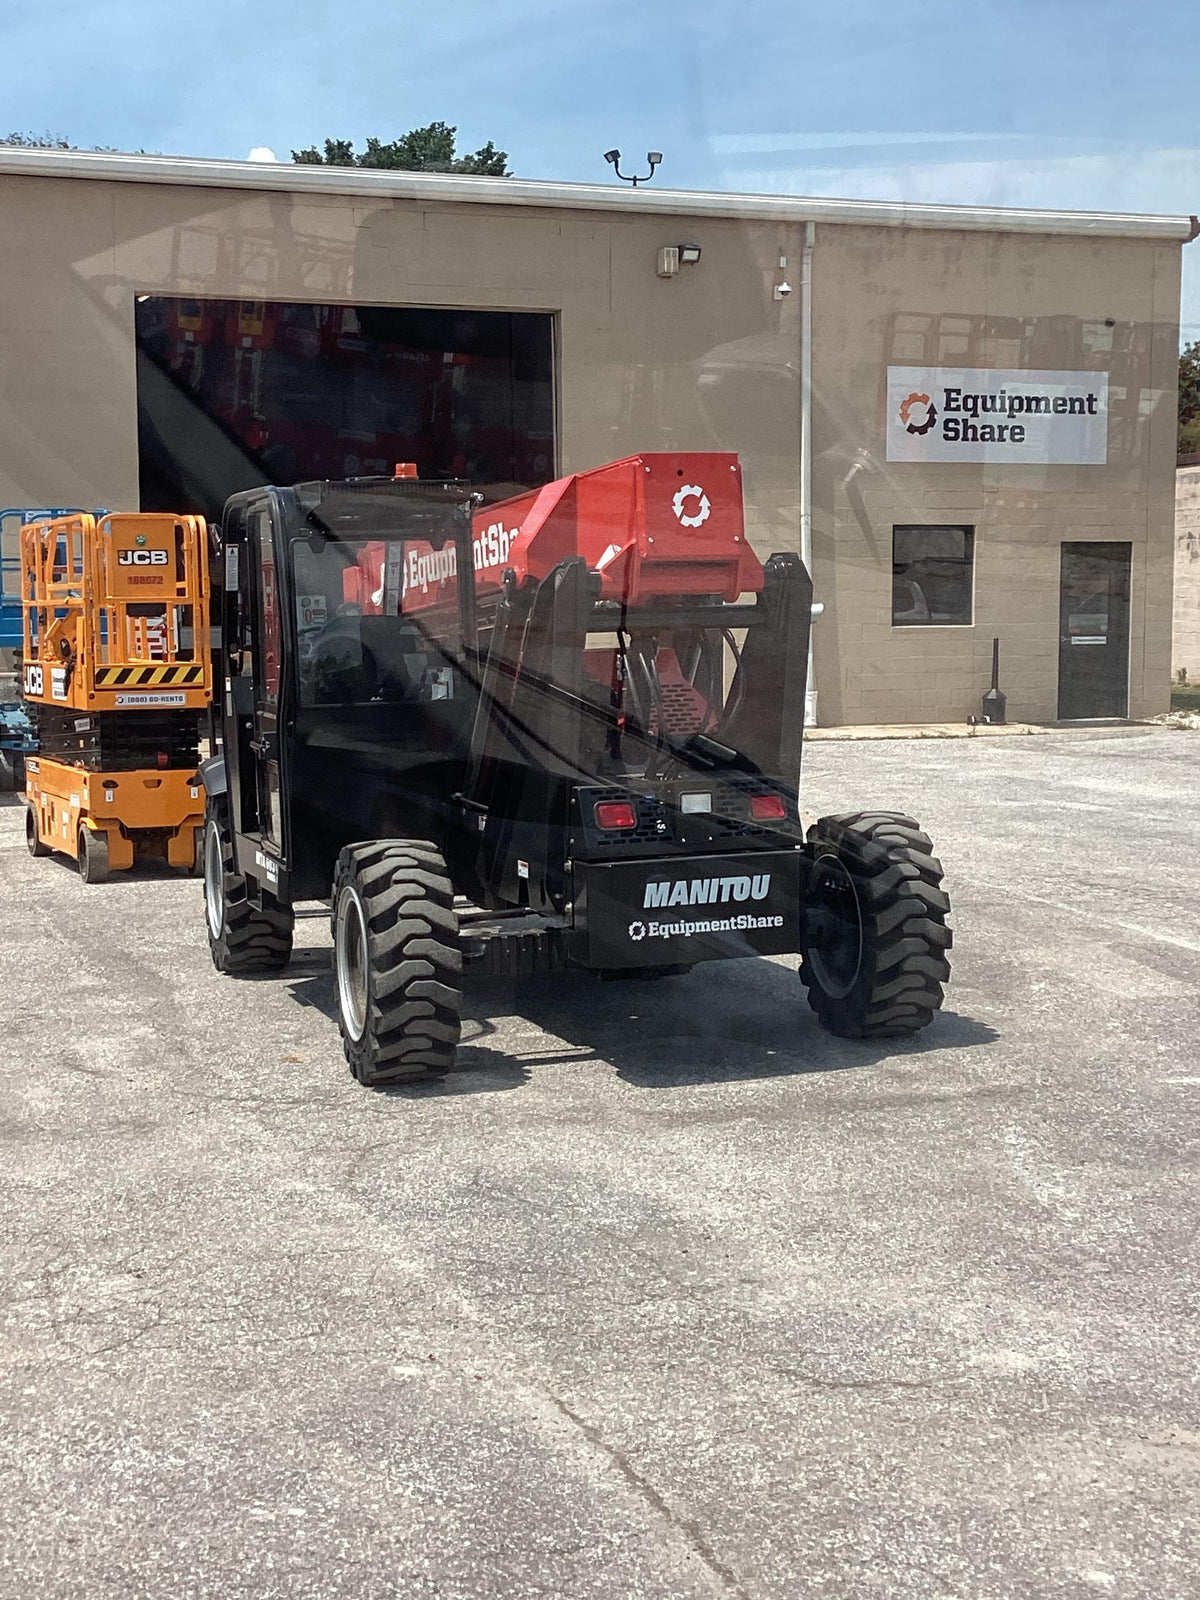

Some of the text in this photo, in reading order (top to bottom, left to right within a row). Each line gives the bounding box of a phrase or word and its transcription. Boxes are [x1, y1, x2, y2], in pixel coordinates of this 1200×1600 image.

[943, 388, 1098, 418] Equipment
[942, 418, 1026, 443] Share
[119, 550, 168, 565] JCB
[24, 665, 44, 695] JCB
[643, 874, 771, 909] MANITOU
[648, 914, 784, 939] EquipmentShare
